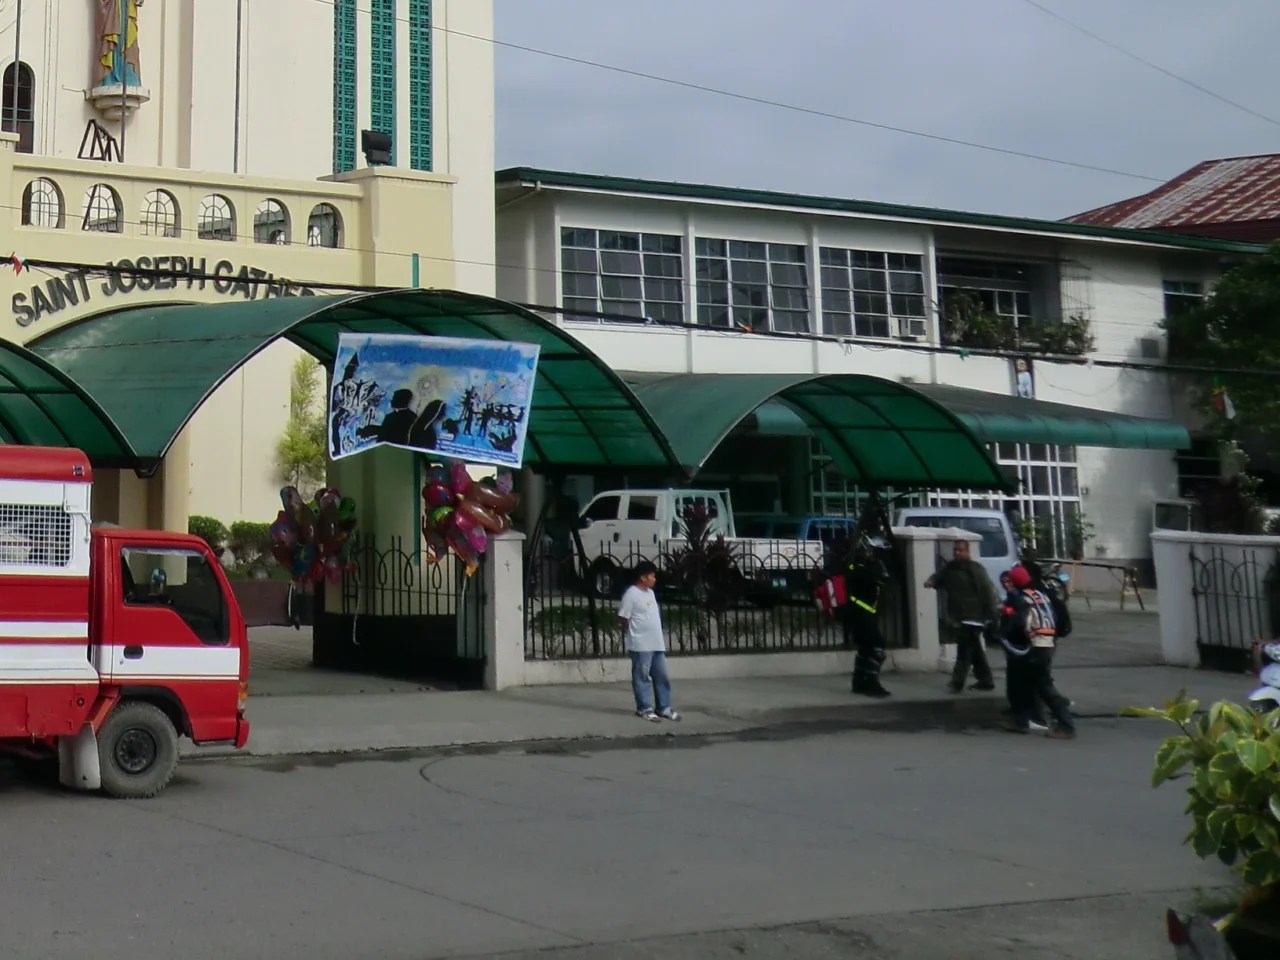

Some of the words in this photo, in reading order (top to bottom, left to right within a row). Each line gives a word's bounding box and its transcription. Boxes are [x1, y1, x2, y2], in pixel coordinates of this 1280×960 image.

[11, 269, 90, 327] SAINT
[102, 255, 206, 297] JOSEPH
[214, 259, 315, 300] CATH
